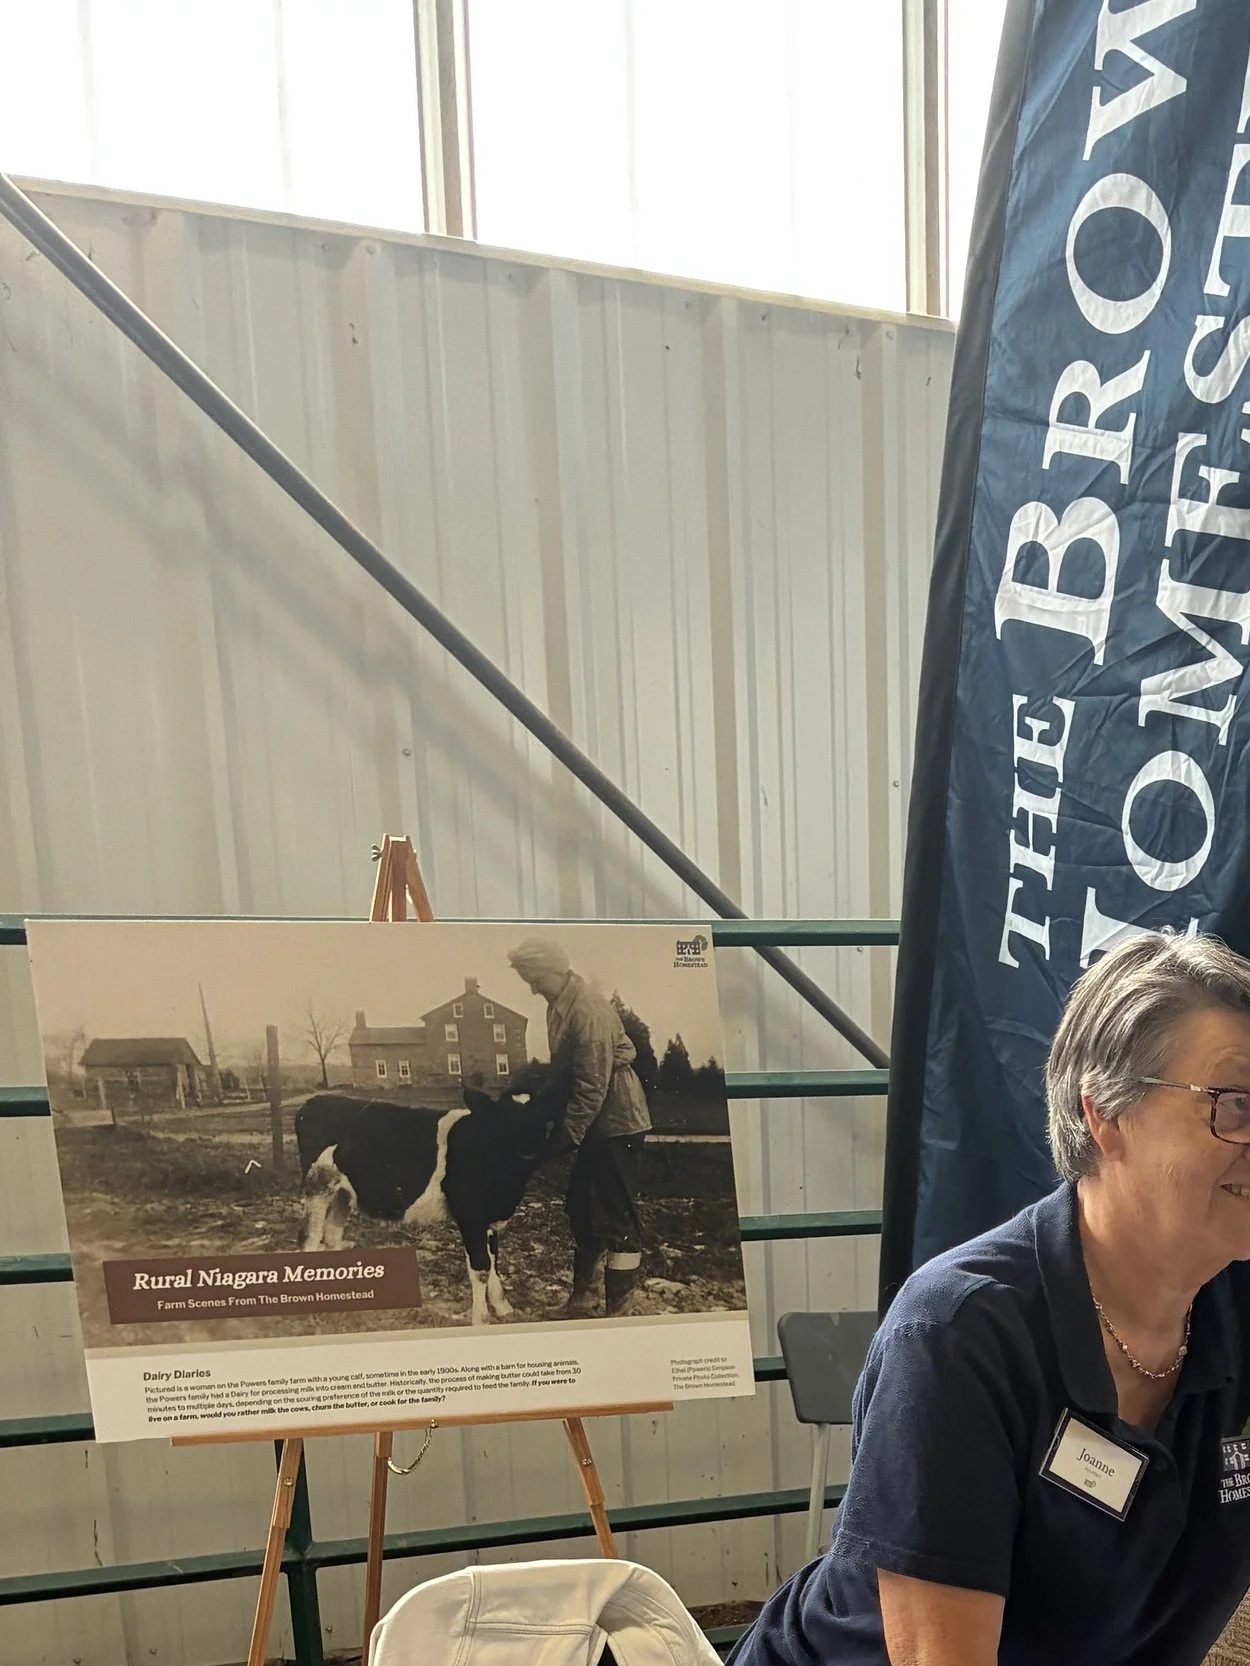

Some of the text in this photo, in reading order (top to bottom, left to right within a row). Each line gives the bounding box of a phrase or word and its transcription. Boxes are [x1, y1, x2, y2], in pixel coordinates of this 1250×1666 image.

[998, 694, 1076, 969] THE
[133, 1261, 385, 1290] Rural Niagara Memories
[158, 1290, 374, 1310] Farm Scenes From The Brown Homestead
[143, 1369, 211, 1381] Dairy Diaries
[179, 1412, 199, 1421] farm,
[223, 1411, 236, 1419] you
[237, 1408, 260, 1416] rather
[311, 1403, 332, 1411] churn
[345, 1400, 369, 1409] butter,
[378, 1398, 396, 1406] cook
[421, 1395, 446, 1405] family?
[1076, 1447, 1116, 1479] Joanne
[1220, 1478, 1234, 1490] THE
